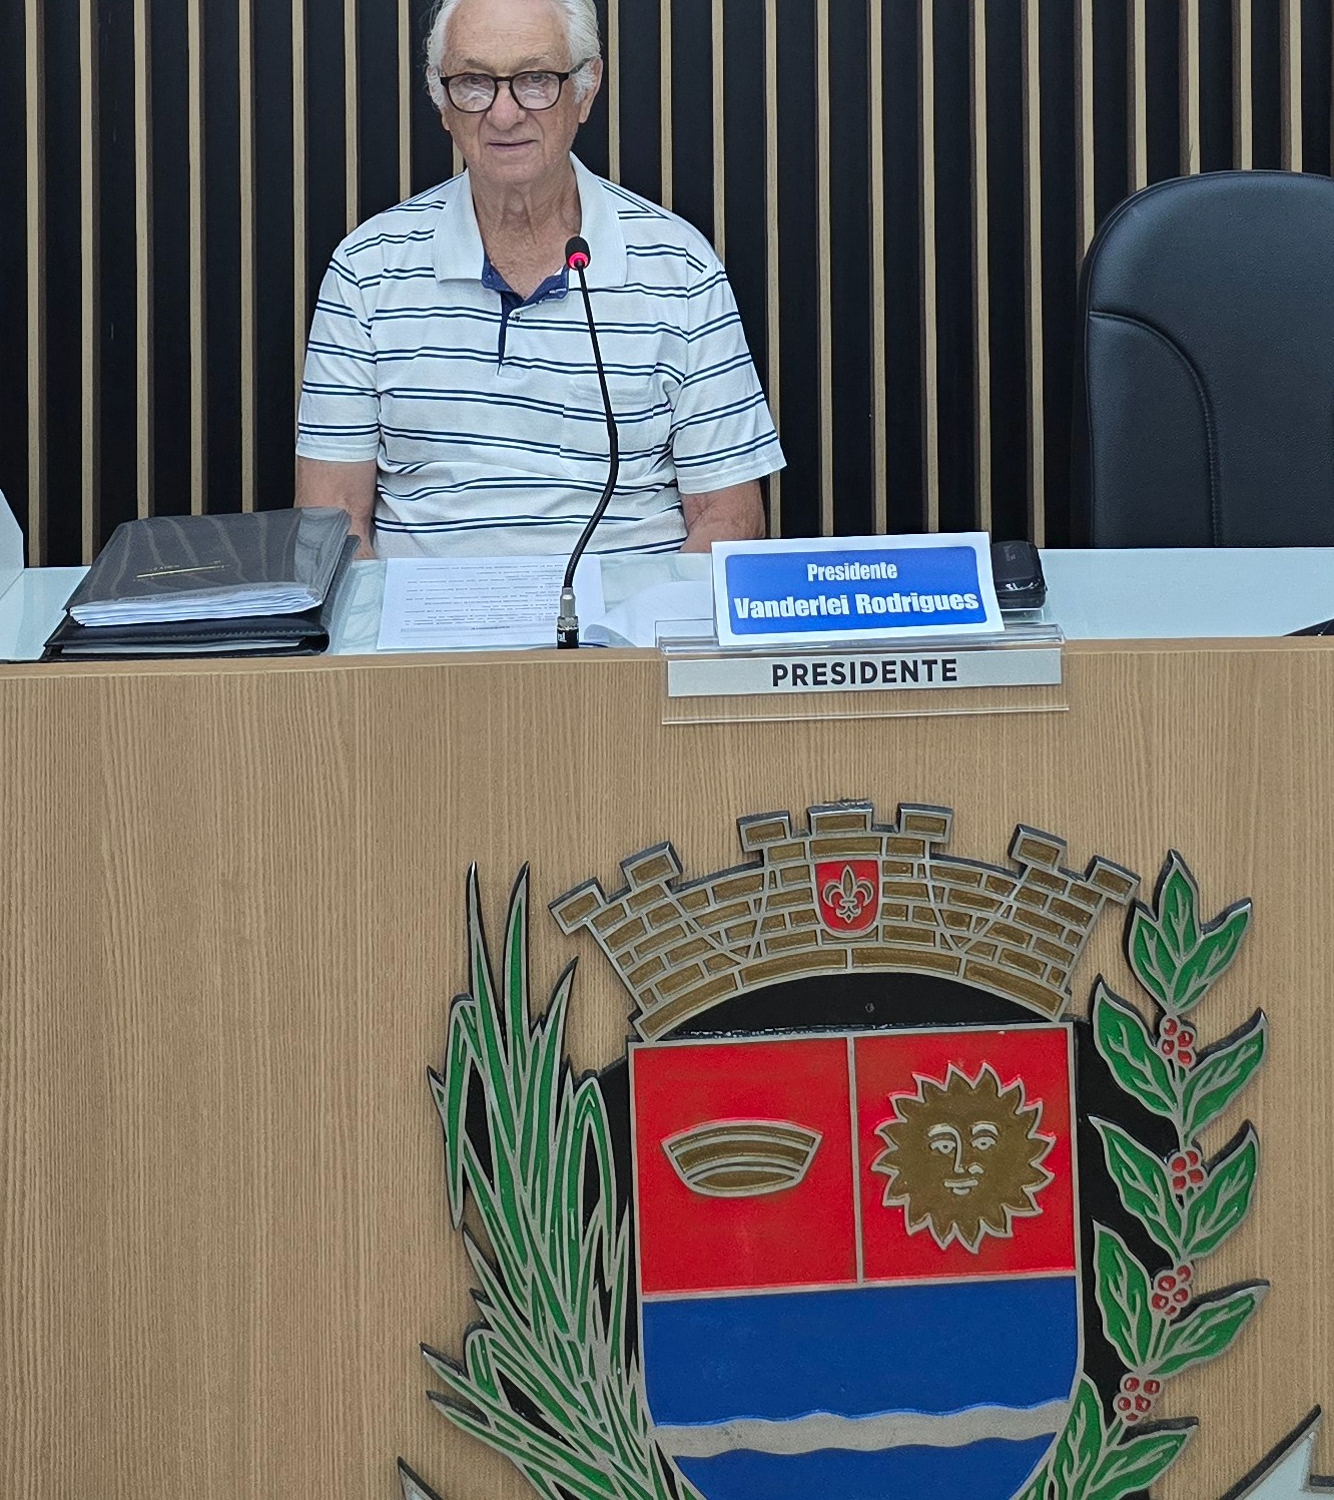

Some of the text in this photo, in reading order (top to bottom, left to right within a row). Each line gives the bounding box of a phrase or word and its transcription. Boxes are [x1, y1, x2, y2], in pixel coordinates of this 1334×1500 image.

[807, 562, 898, 582] Presidente
[734, 591, 979, 619] Vanderlei Rodrigues
[772, 658, 958, 687] PRESIDENTE
